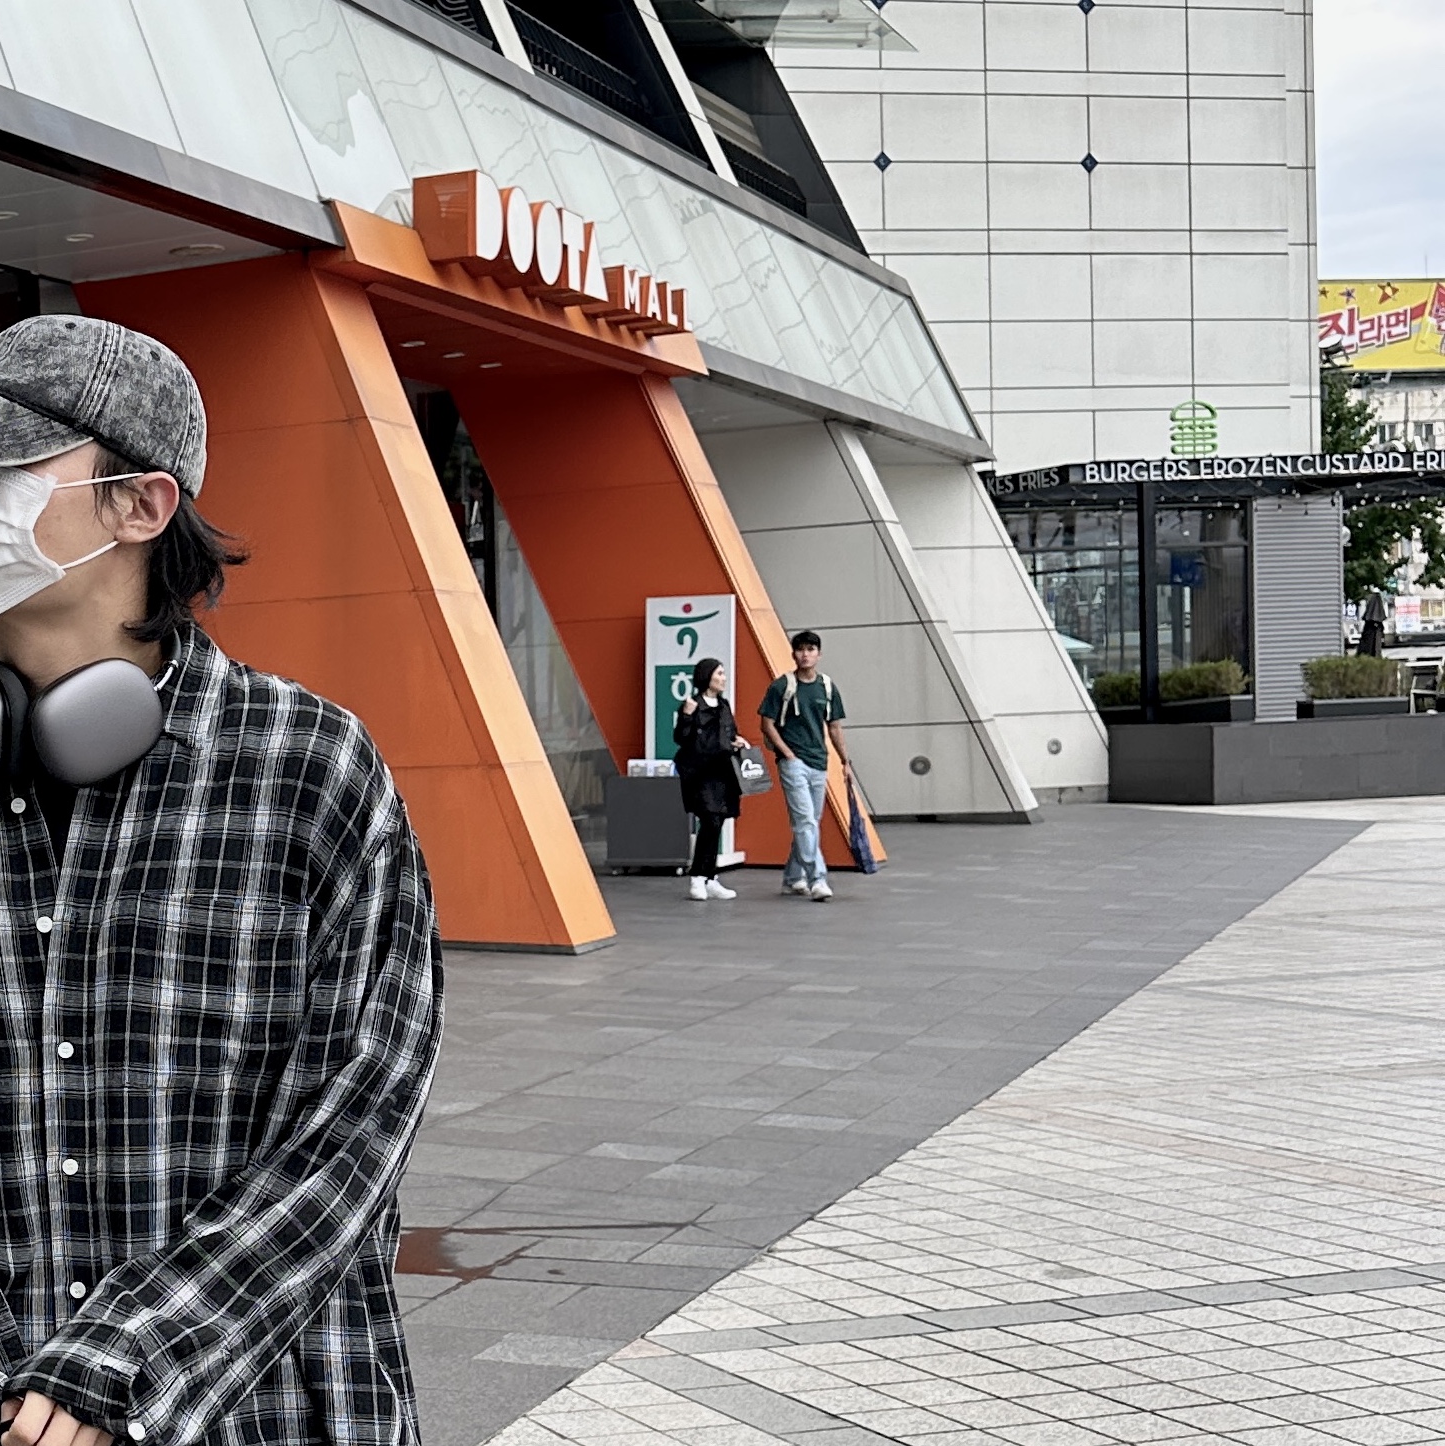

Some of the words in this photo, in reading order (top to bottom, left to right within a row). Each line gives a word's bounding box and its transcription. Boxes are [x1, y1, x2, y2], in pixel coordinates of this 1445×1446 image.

[475, 170, 608, 302] DOOTA
[622, 264, 693, 332] MALL
[1019, 468, 1060, 492] FRIES
[1085, 460, 1190, 483] BURGERS
[1297, 453, 1405, 474] CUSTARD
